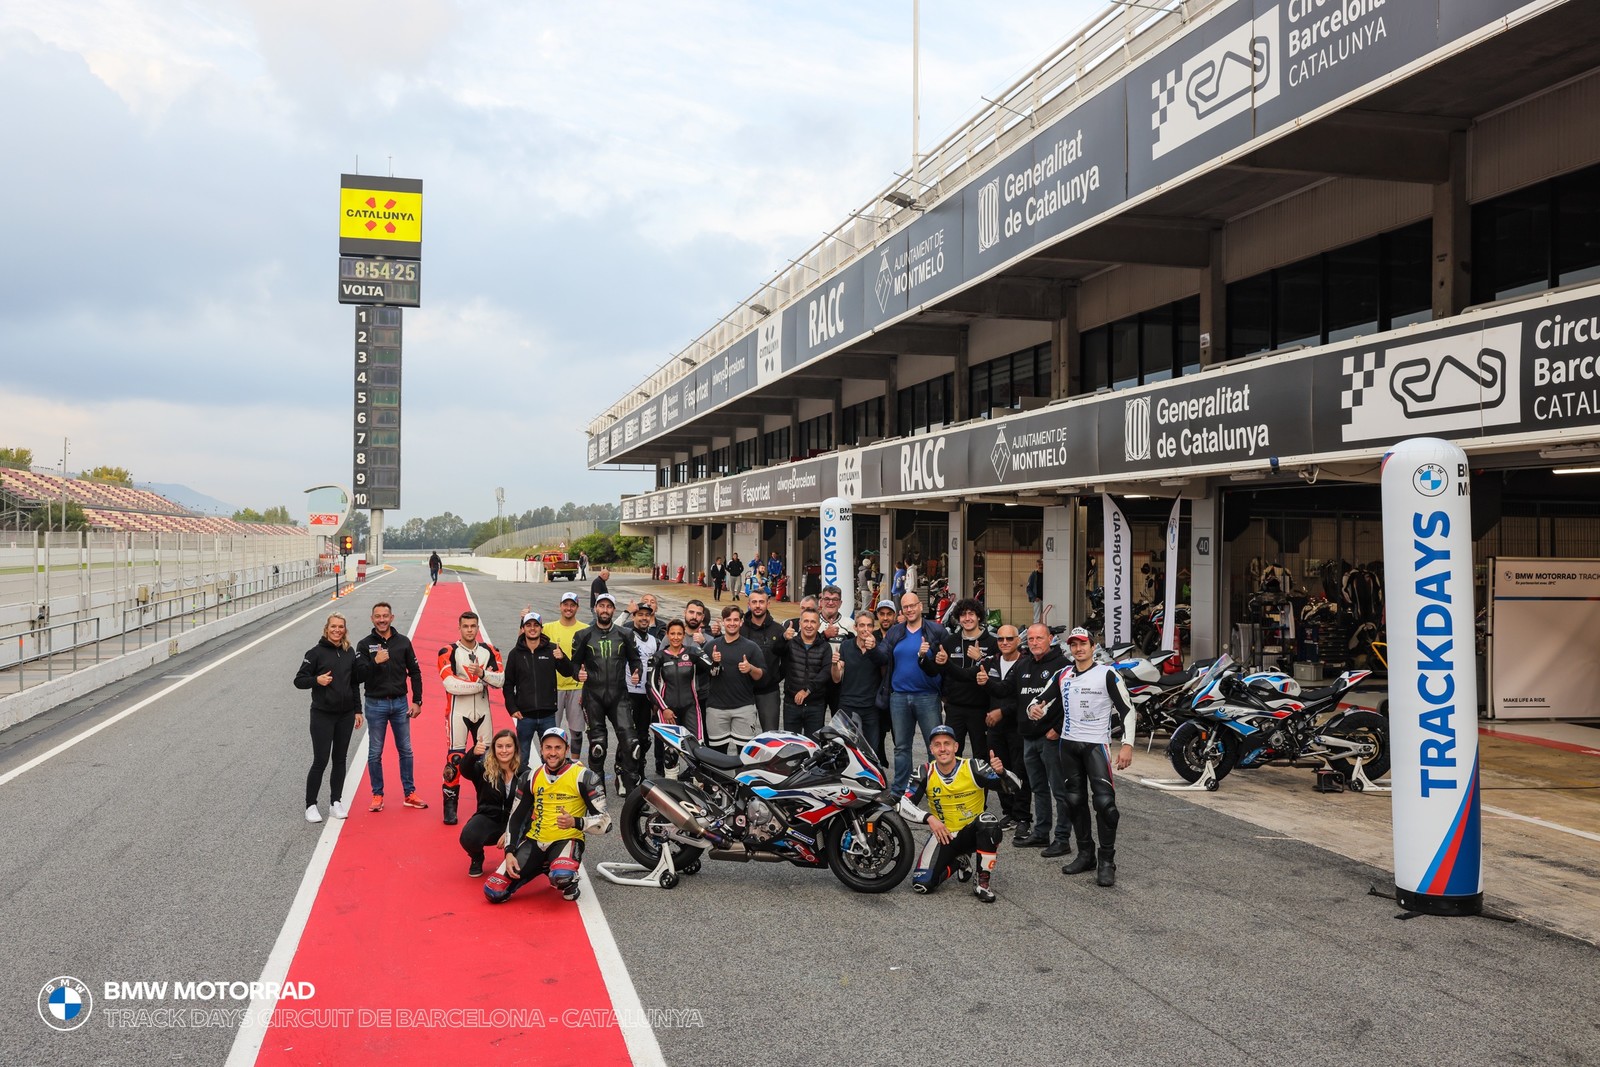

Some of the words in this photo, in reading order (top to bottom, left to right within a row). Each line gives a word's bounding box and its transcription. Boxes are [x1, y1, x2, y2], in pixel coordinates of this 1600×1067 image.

[1289, 16, 1387, 87] CATALUNYA
[1004, 129, 1083, 202] Generalitat
[1004, 208, 1022, 238] de
[1025, 165, 1100, 226] Catalunya
[346, 208, 414, 221] CATALUNYA
[894, 231, 935, 272] AJUNTAMENT
[935, 229, 944, 246] DE
[355, 260, 415, 280] 8:54:25
[894, 247, 945, 296] MONTMELÓ
[343, 284, 384, 297] VOLTA
[359, 311, 366, 322] 1
[809, 282, 844, 348] RACC
[358, 332, 367, 343] 2
[358, 352, 367, 363] 3
[357, 372, 367, 383] 4
[357, 393, 366, 404] 5
[1157, 384, 1250, 425] Generalitat
[357, 412, 366, 424] 6
[357, 433, 366, 444] 7
[1012, 430, 1056, 449] AJUNTAMENT
[1057, 427, 1067, 441] DE
[1157, 432, 1177, 459] de
[1180, 423, 1270, 456] Catalunya
[356, 453, 366, 464] 8
[900, 436, 946, 492] RACC
[1012, 443, 1067, 471] MONTMELÓ
[356, 473, 366, 485] 9
[355, 493, 367, 505] 10
[1199, 540, 1209, 552] 40
[1413, 511, 1457, 798] TRACKDAYS
